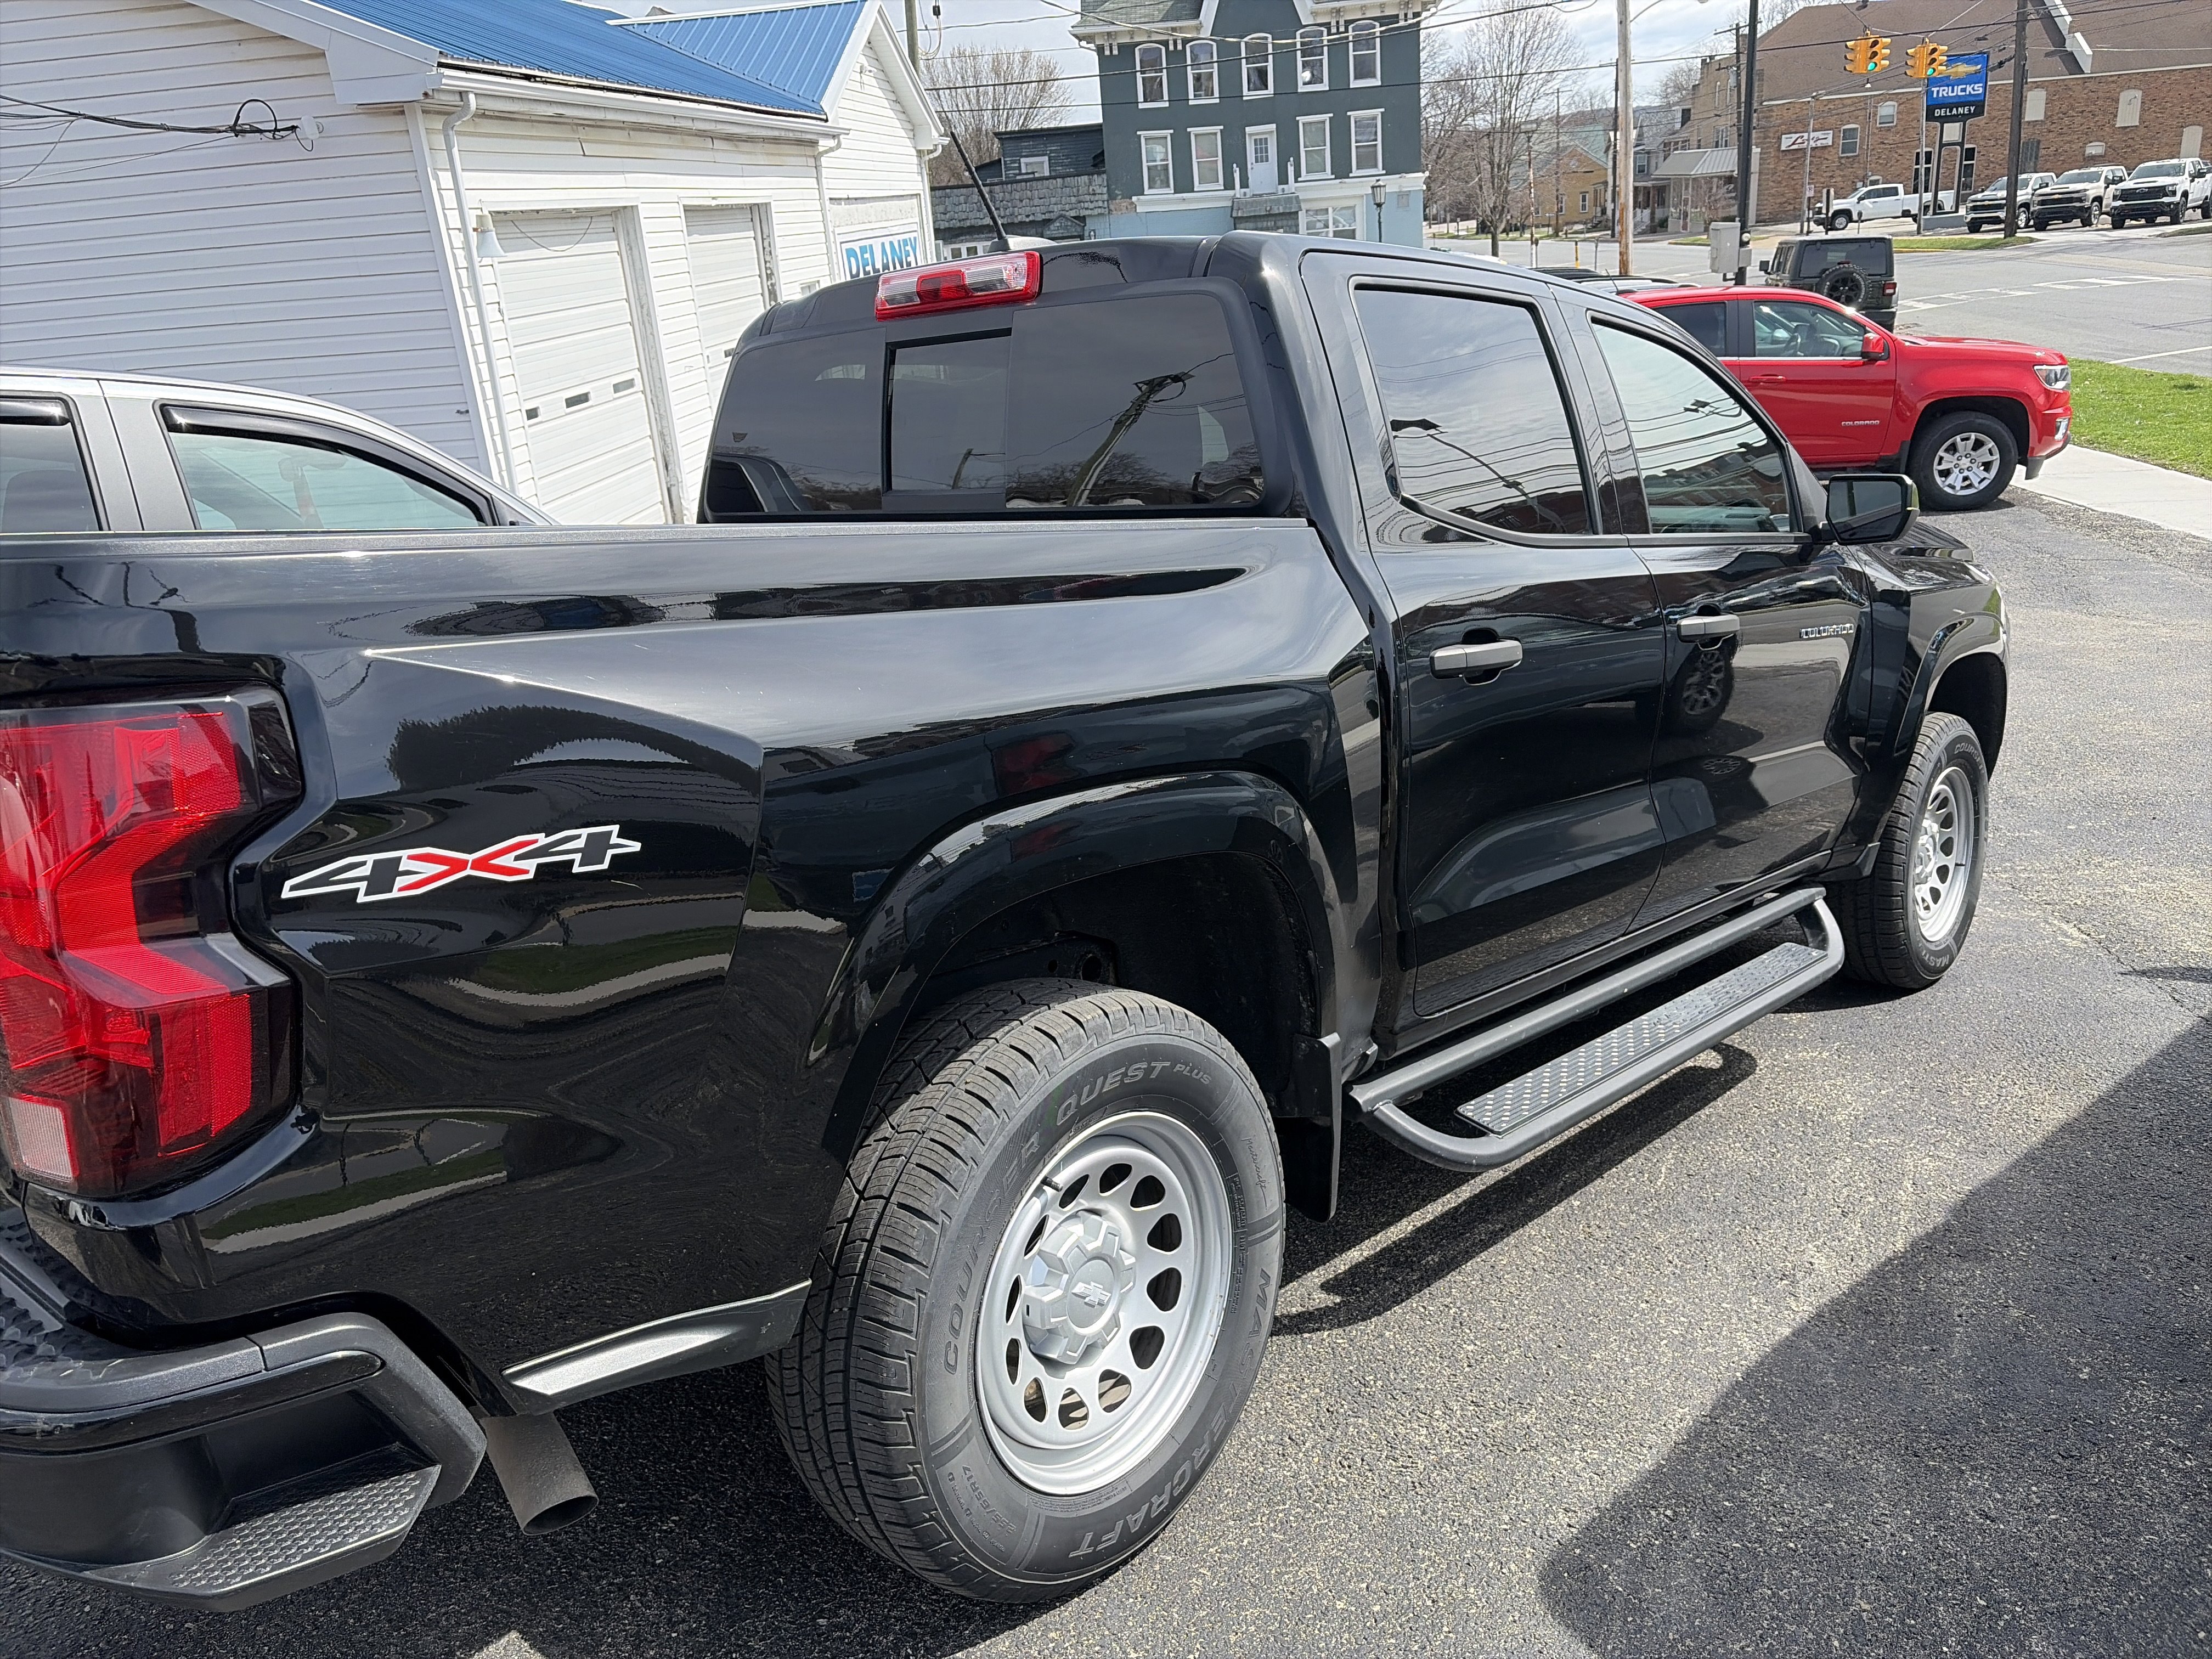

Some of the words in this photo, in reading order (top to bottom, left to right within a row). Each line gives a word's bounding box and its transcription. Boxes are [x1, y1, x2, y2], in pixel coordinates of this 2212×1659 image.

[1931, 83, 1983, 98] TRUCKS
[1934, 106, 1976, 116] DELANEY
[845, 236, 918, 279] DELANEY
[1801, 624, 1854, 639] COLORADO
[944, 1132, 1041, 1375] COURSER
[1056, 1061, 1171, 1127] QUEST
[1173, 1063, 1212, 1085] PLUS
[1069, 1267, 1271, 1558] MASTERCRAFT
[962, 1465, 1017, 1536] 255/65R17
